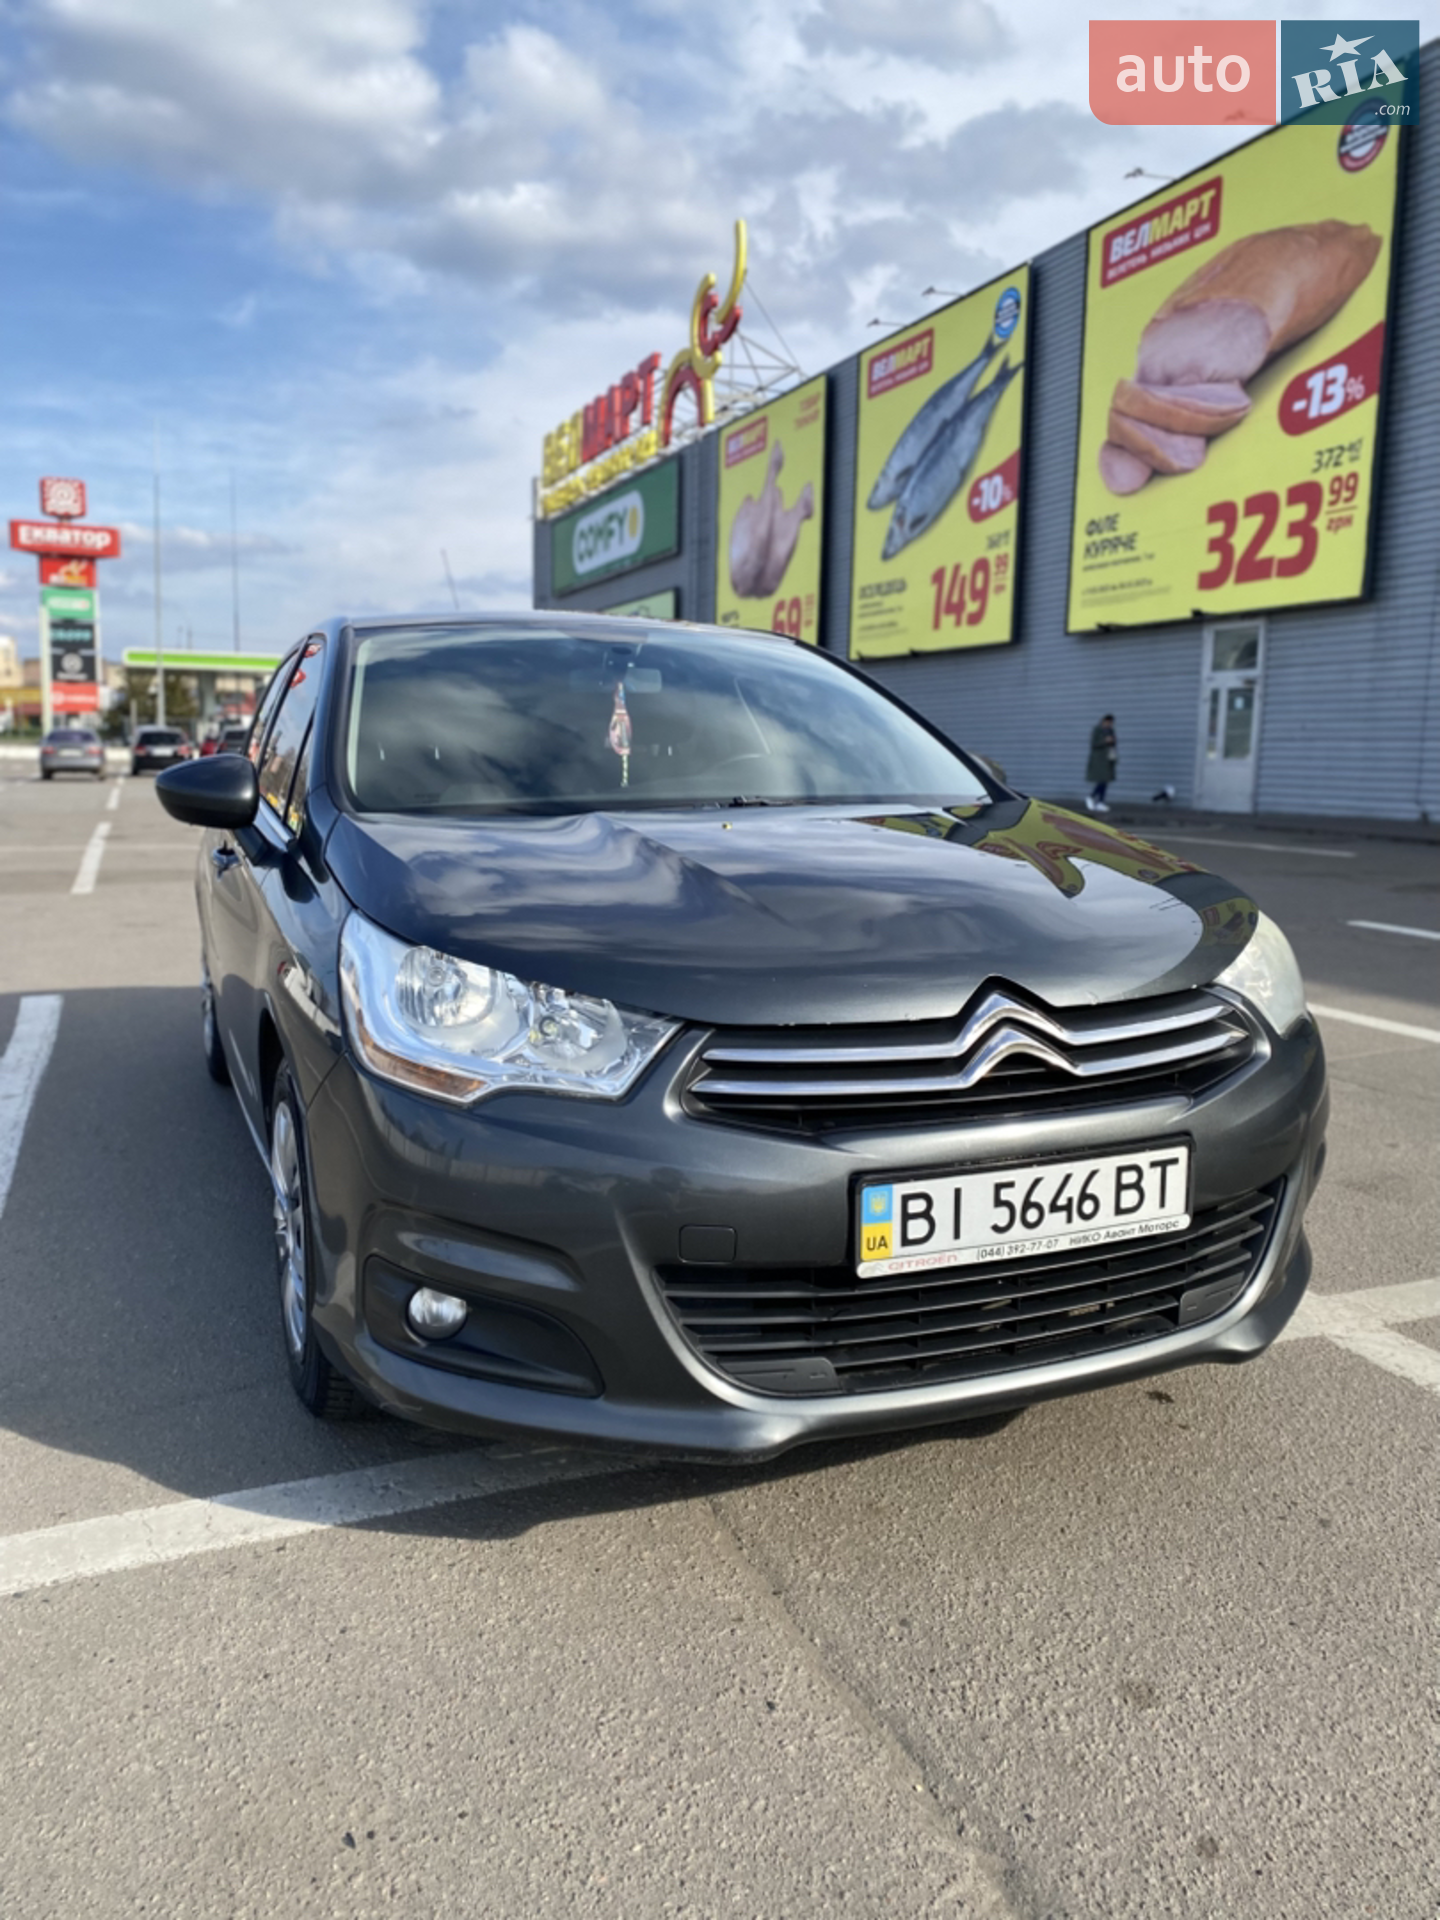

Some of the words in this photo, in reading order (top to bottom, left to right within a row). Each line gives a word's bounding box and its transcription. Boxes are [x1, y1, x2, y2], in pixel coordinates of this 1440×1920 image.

[1109, 188, 1217, 265] ВЕЛМАРТ
[1291, 364, 1365, 420] -13%
[577, 508, 628, 564] COMFY
[1197, 480, 1324, 592] 323
[1328, 471, 1360, 507] 99
[930, 556, 991, 631] 149
[900, 1187, 963, 1248] BI
[990, 1168, 1101, 1235] 5646
[1114, 1157, 1180, 1216] BT
[1137, 1219, 1180, 1235] Моторс
[866, 1235, 889, 1251] UA
[976, 1244, 1006, 1262] (044)
